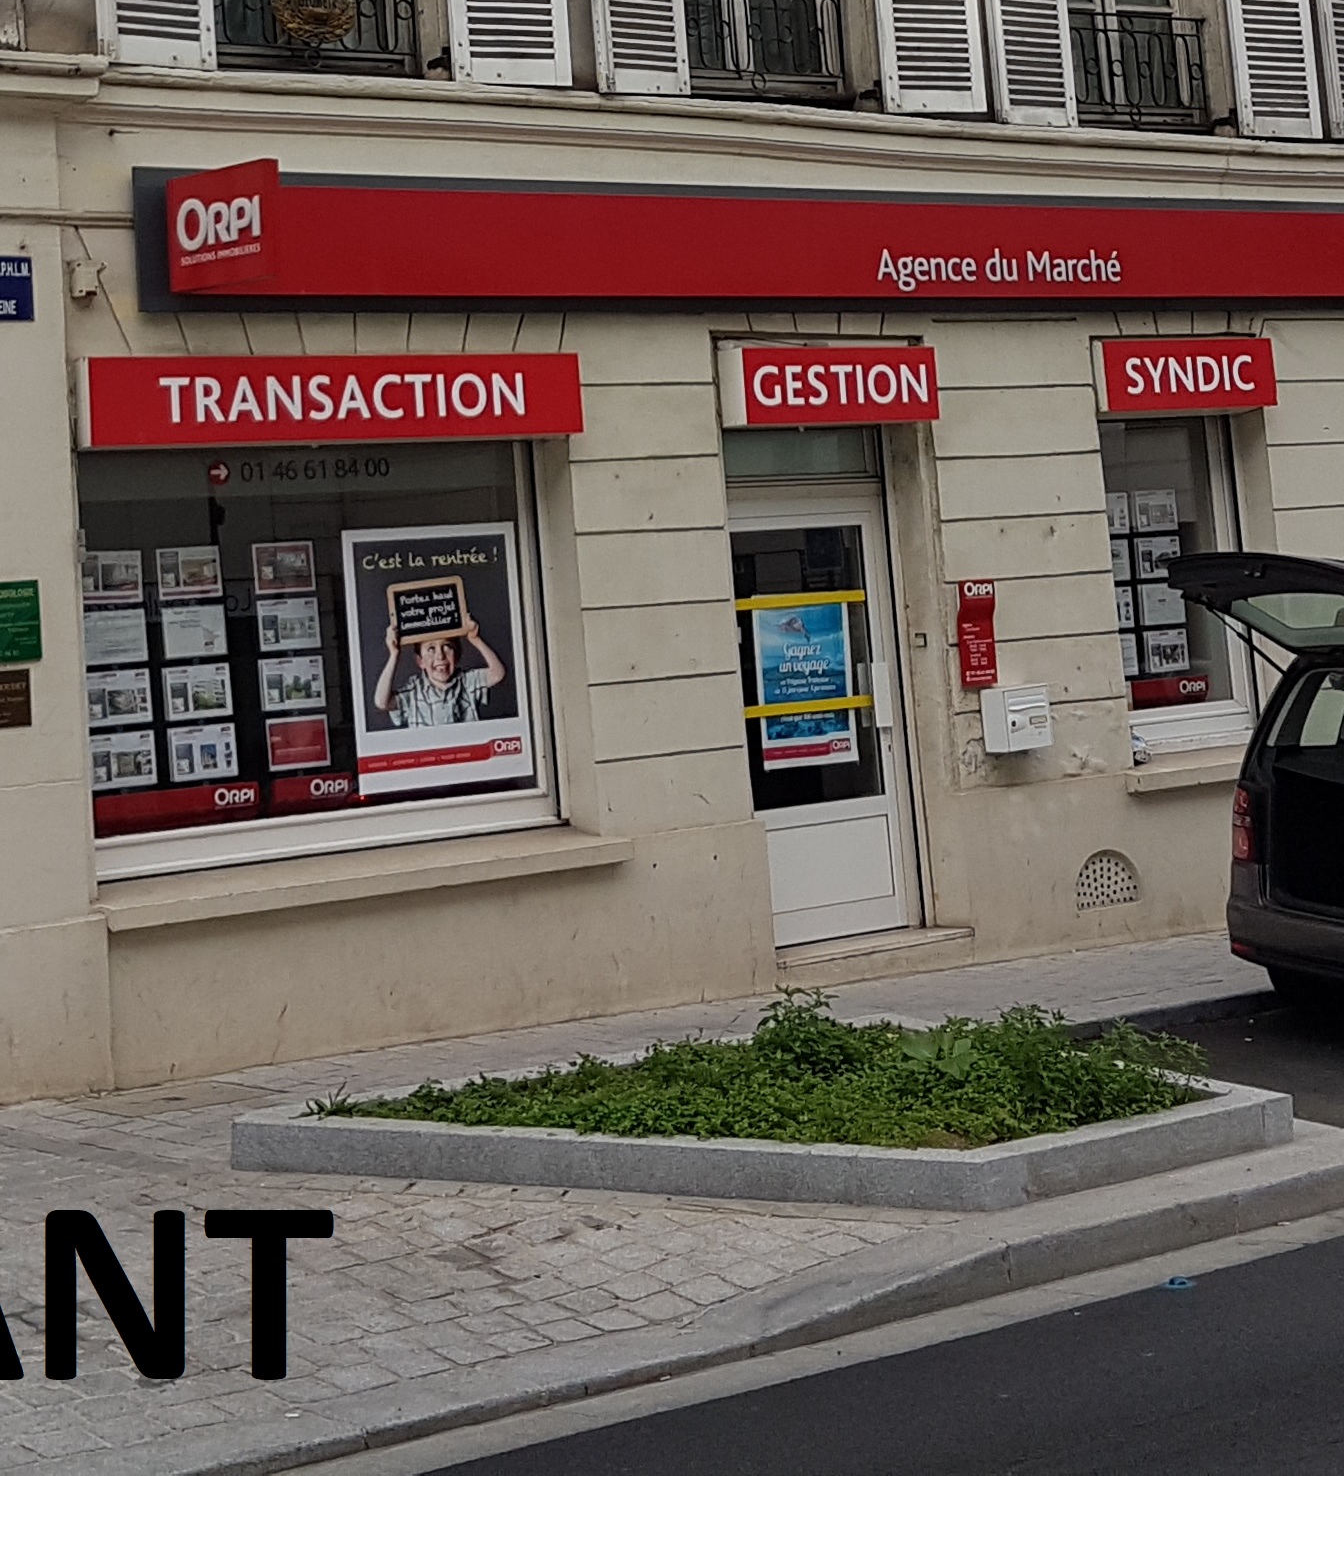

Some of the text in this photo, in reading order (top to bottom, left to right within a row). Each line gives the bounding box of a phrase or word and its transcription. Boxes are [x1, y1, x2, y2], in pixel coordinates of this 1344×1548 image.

[177, 194, 261, 252] ORPI
[879, 249, 1120, 290] Agence du Marché
[754, 365, 927, 405] GESTION
[1126, 356, 1254, 393] SYNDIC
[160, 374, 524, 422] TRANSACTION
[240, 458, 390, 482] 01 46 61 84 00
[362, 554, 402, 570] C'est
[409, 552, 425, 567] la
[431, 548, 488, 567] rentrée
[964, 582, 993, 596] ORPI
[783, 642, 822, 660] Gagnez
[1179, 681, 1206, 694] ORPI
[493, 740, 522, 753] ORPI
[214, 788, 255, 806] ORPI
[310, 778, 349, 796] ORPI
